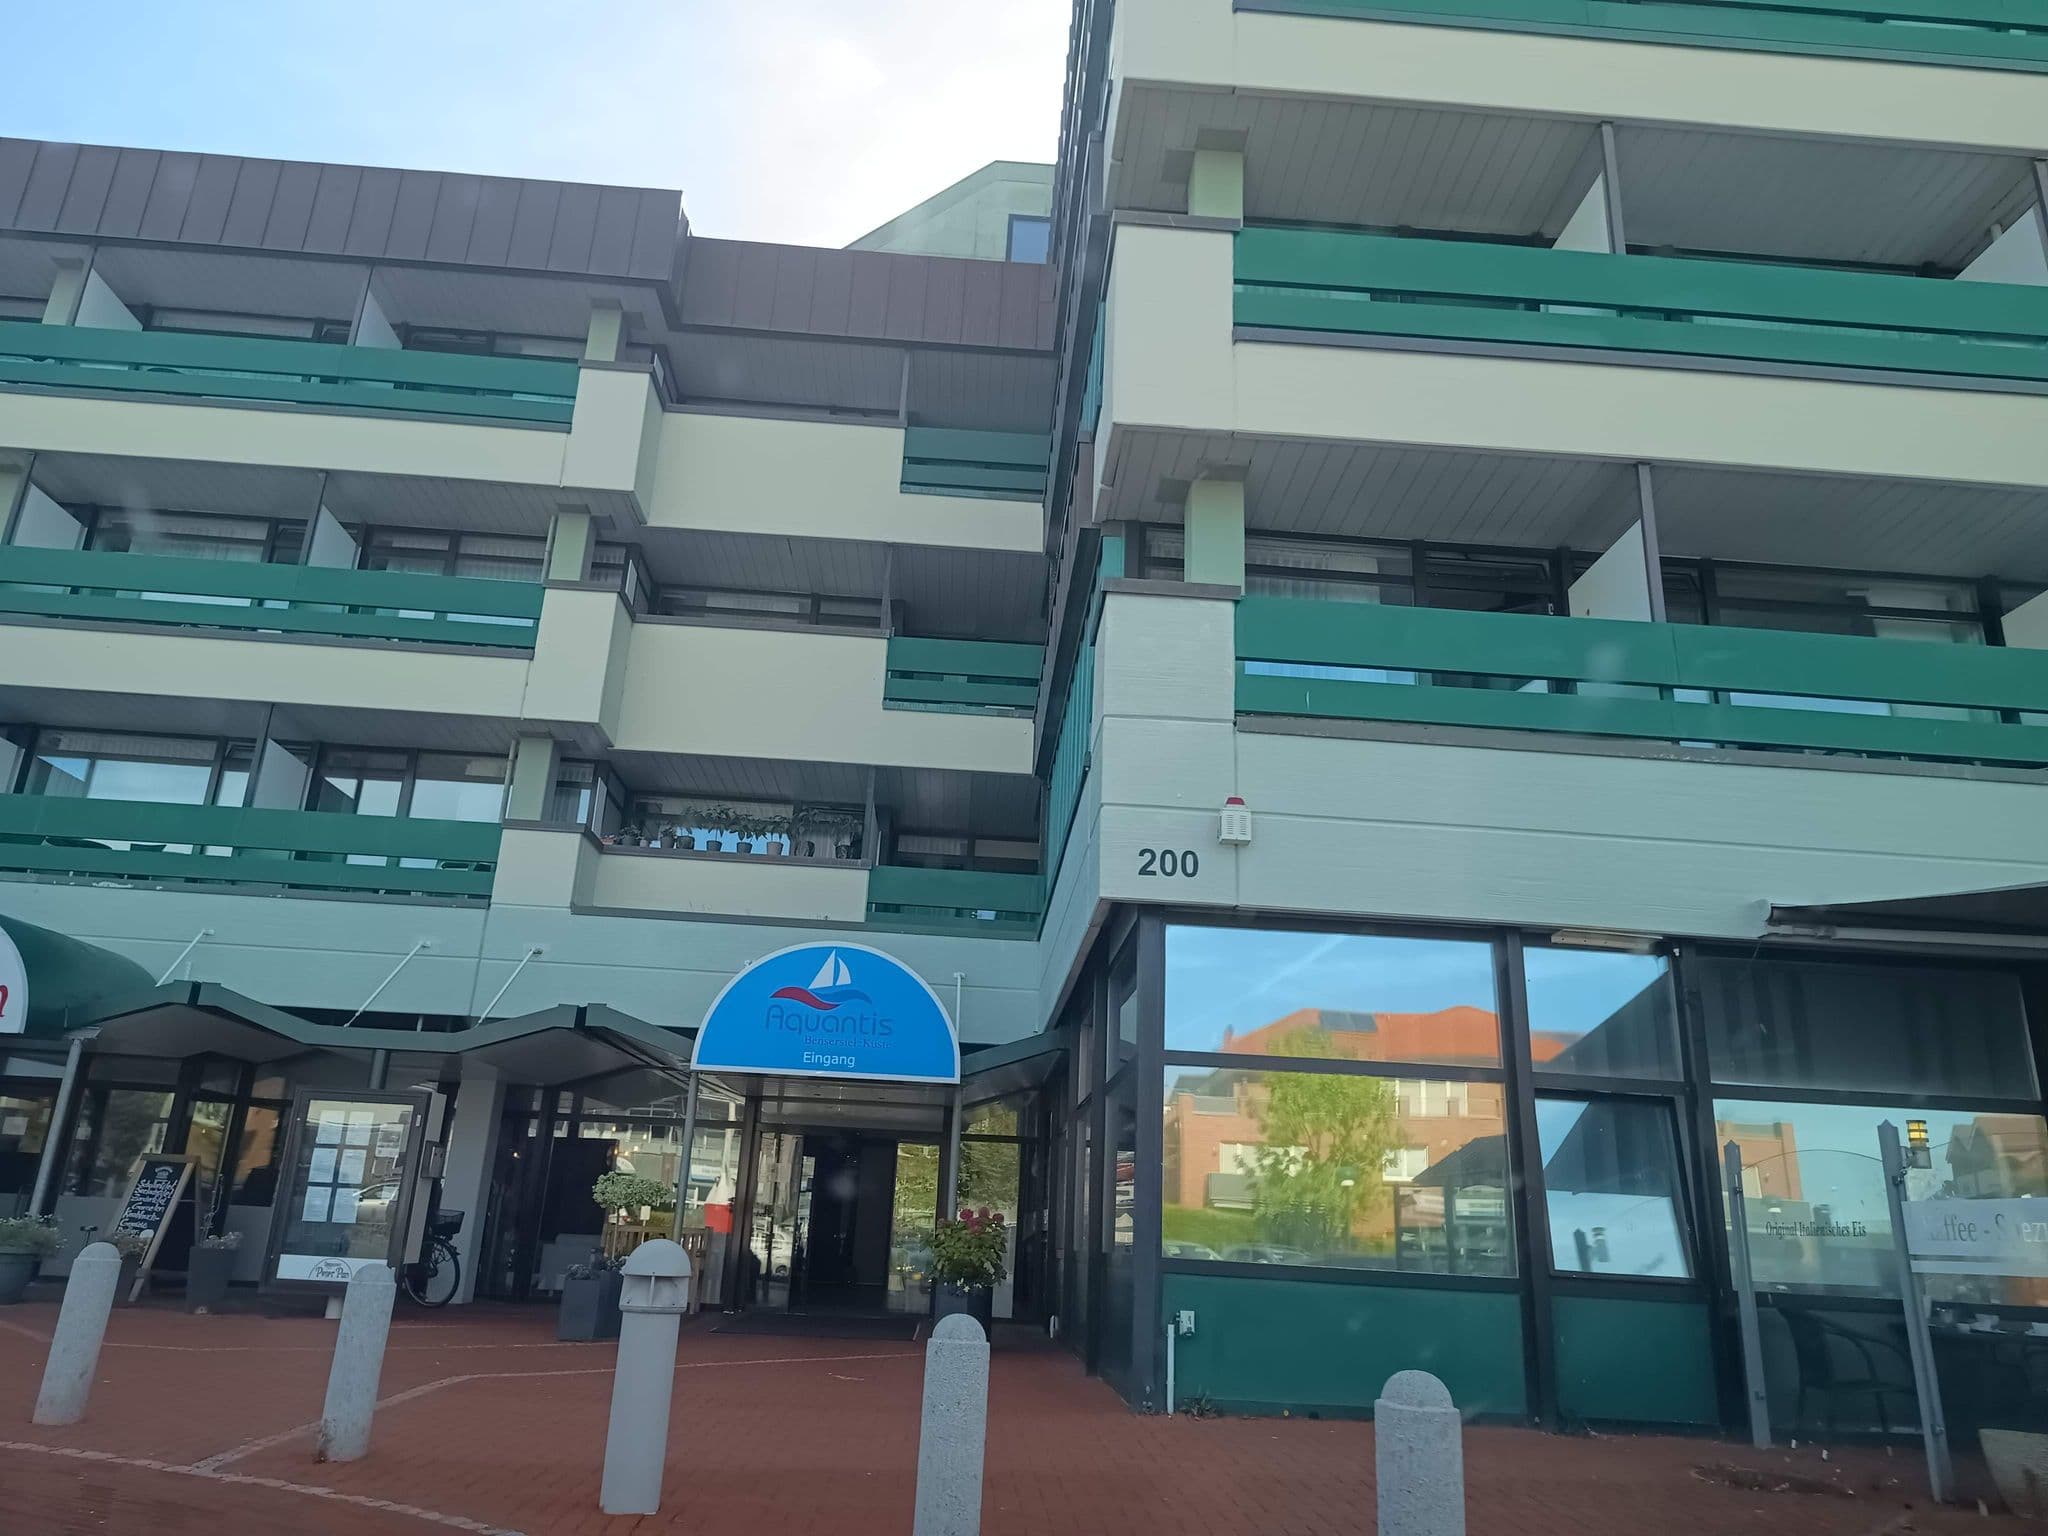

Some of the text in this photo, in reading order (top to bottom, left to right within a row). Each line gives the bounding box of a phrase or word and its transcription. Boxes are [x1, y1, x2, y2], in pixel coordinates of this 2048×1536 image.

[1138, 848, 1199, 878] 200
[765, 1004, 893, 1036] Aquantis
[803, 1051, 856, 1068] Eingang
[1766, 1221, 1867, 1240] Original Italienisches Eis
